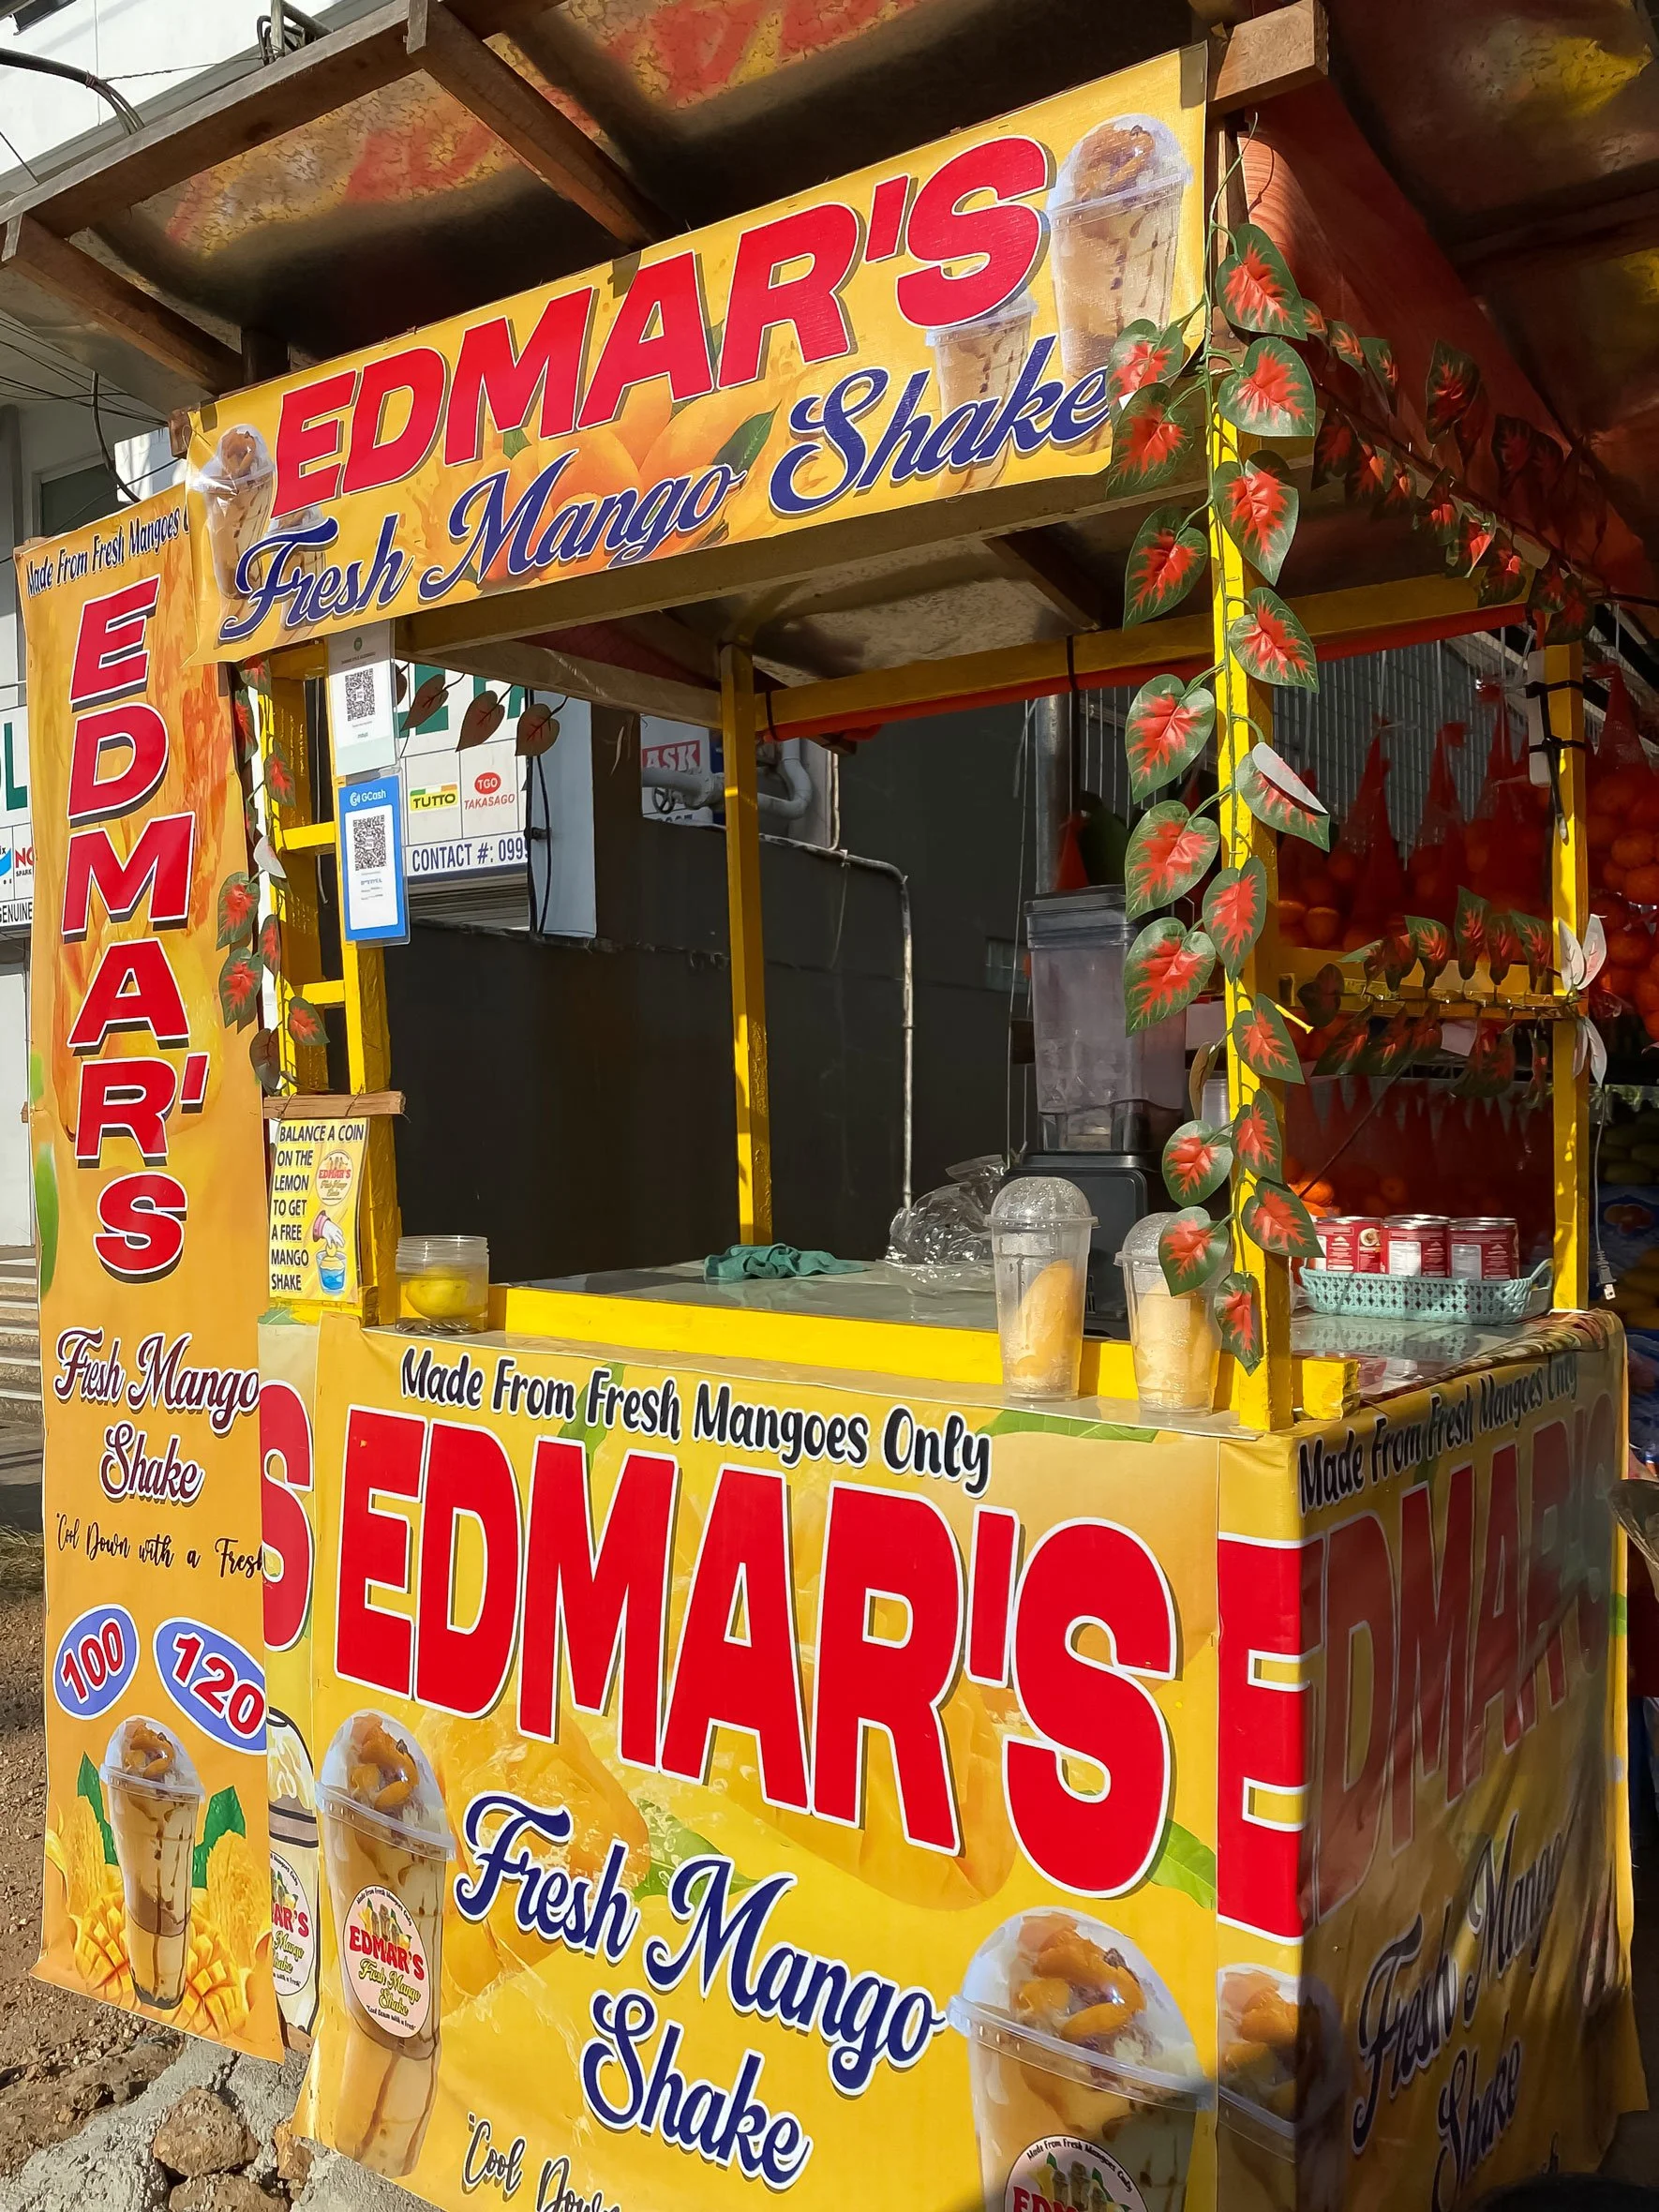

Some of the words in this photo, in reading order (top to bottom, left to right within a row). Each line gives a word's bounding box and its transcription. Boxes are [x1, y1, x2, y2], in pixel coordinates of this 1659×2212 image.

[271, 134, 1052, 520] EDMAR'S
[219, 512, 415, 641] Fresh
[423, 449, 747, 593] Mango
[770, 335, 1109, 516] Shake
[26, 556, 53, 598] Made
[57, 548, 88, 584] From
[92, 526, 125, 572] Fresh
[129, 506, 181, 560] Mangoes
[361, 789, 386, 801] GCash
[413, 793, 456, 809] TUTTO
[464, 793, 516, 810] TAKASAGO
[477, 777, 499, 790] TGO
[412, 843, 472, 872] CONTACT
[279, 1125, 326, 1143] BALANCE
[327, 1126, 336, 1142] A
[338, 1124, 365, 1142] COIN
[277, 1150, 292, 1167] ON
[295, 1150, 314, 1167] THE
[275, 1174, 309, 1191] LEMON
[273, 1200, 287, 1217] TO
[289, 1199, 307, 1217] GET
[271, 1224, 278, 1241] A
[280, 1224, 302, 1241] FREE
[271, 1248, 309, 1266] MANGO
[271, 1273, 302, 1291] SHAKE
[53, 1326, 127, 1403] Fresh
[127, 1331, 261, 1435] Mango
[399, 1344, 486, 1409] Made
[491, 1356, 576, 1423] From
[586, 1366, 682, 1443] Fresh
[693, 1381, 870, 1471] Mangoes
[883, 1405, 994, 1499] Only
[98, 1420, 206, 1504] Shake
[1297, 1427, 1365, 1517] Made
[1370, 1414, 1422, 1486] From
[1426, 1382, 1474, 1460] Fresh
[86, 1520, 130, 1562] Down
[138, 1533, 174, 1569] with
[187, 1547, 201, 1569] a
[60, 1620, 127, 1704] 100
[334, 1404, 1179, 1900] EDMAR'S
[171, 1632, 267, 1738] 120
[272, 1904, 309, 1937] AR'S
[349, 1924, 426, 1980] EDMAR'S
[453, 1789, 640, 1965] Fresh
[643, 1852, 948, 2098] Mango
[387, 1970, 422, 2006] Mango
[577, 1987, 815, 2193] Shake
